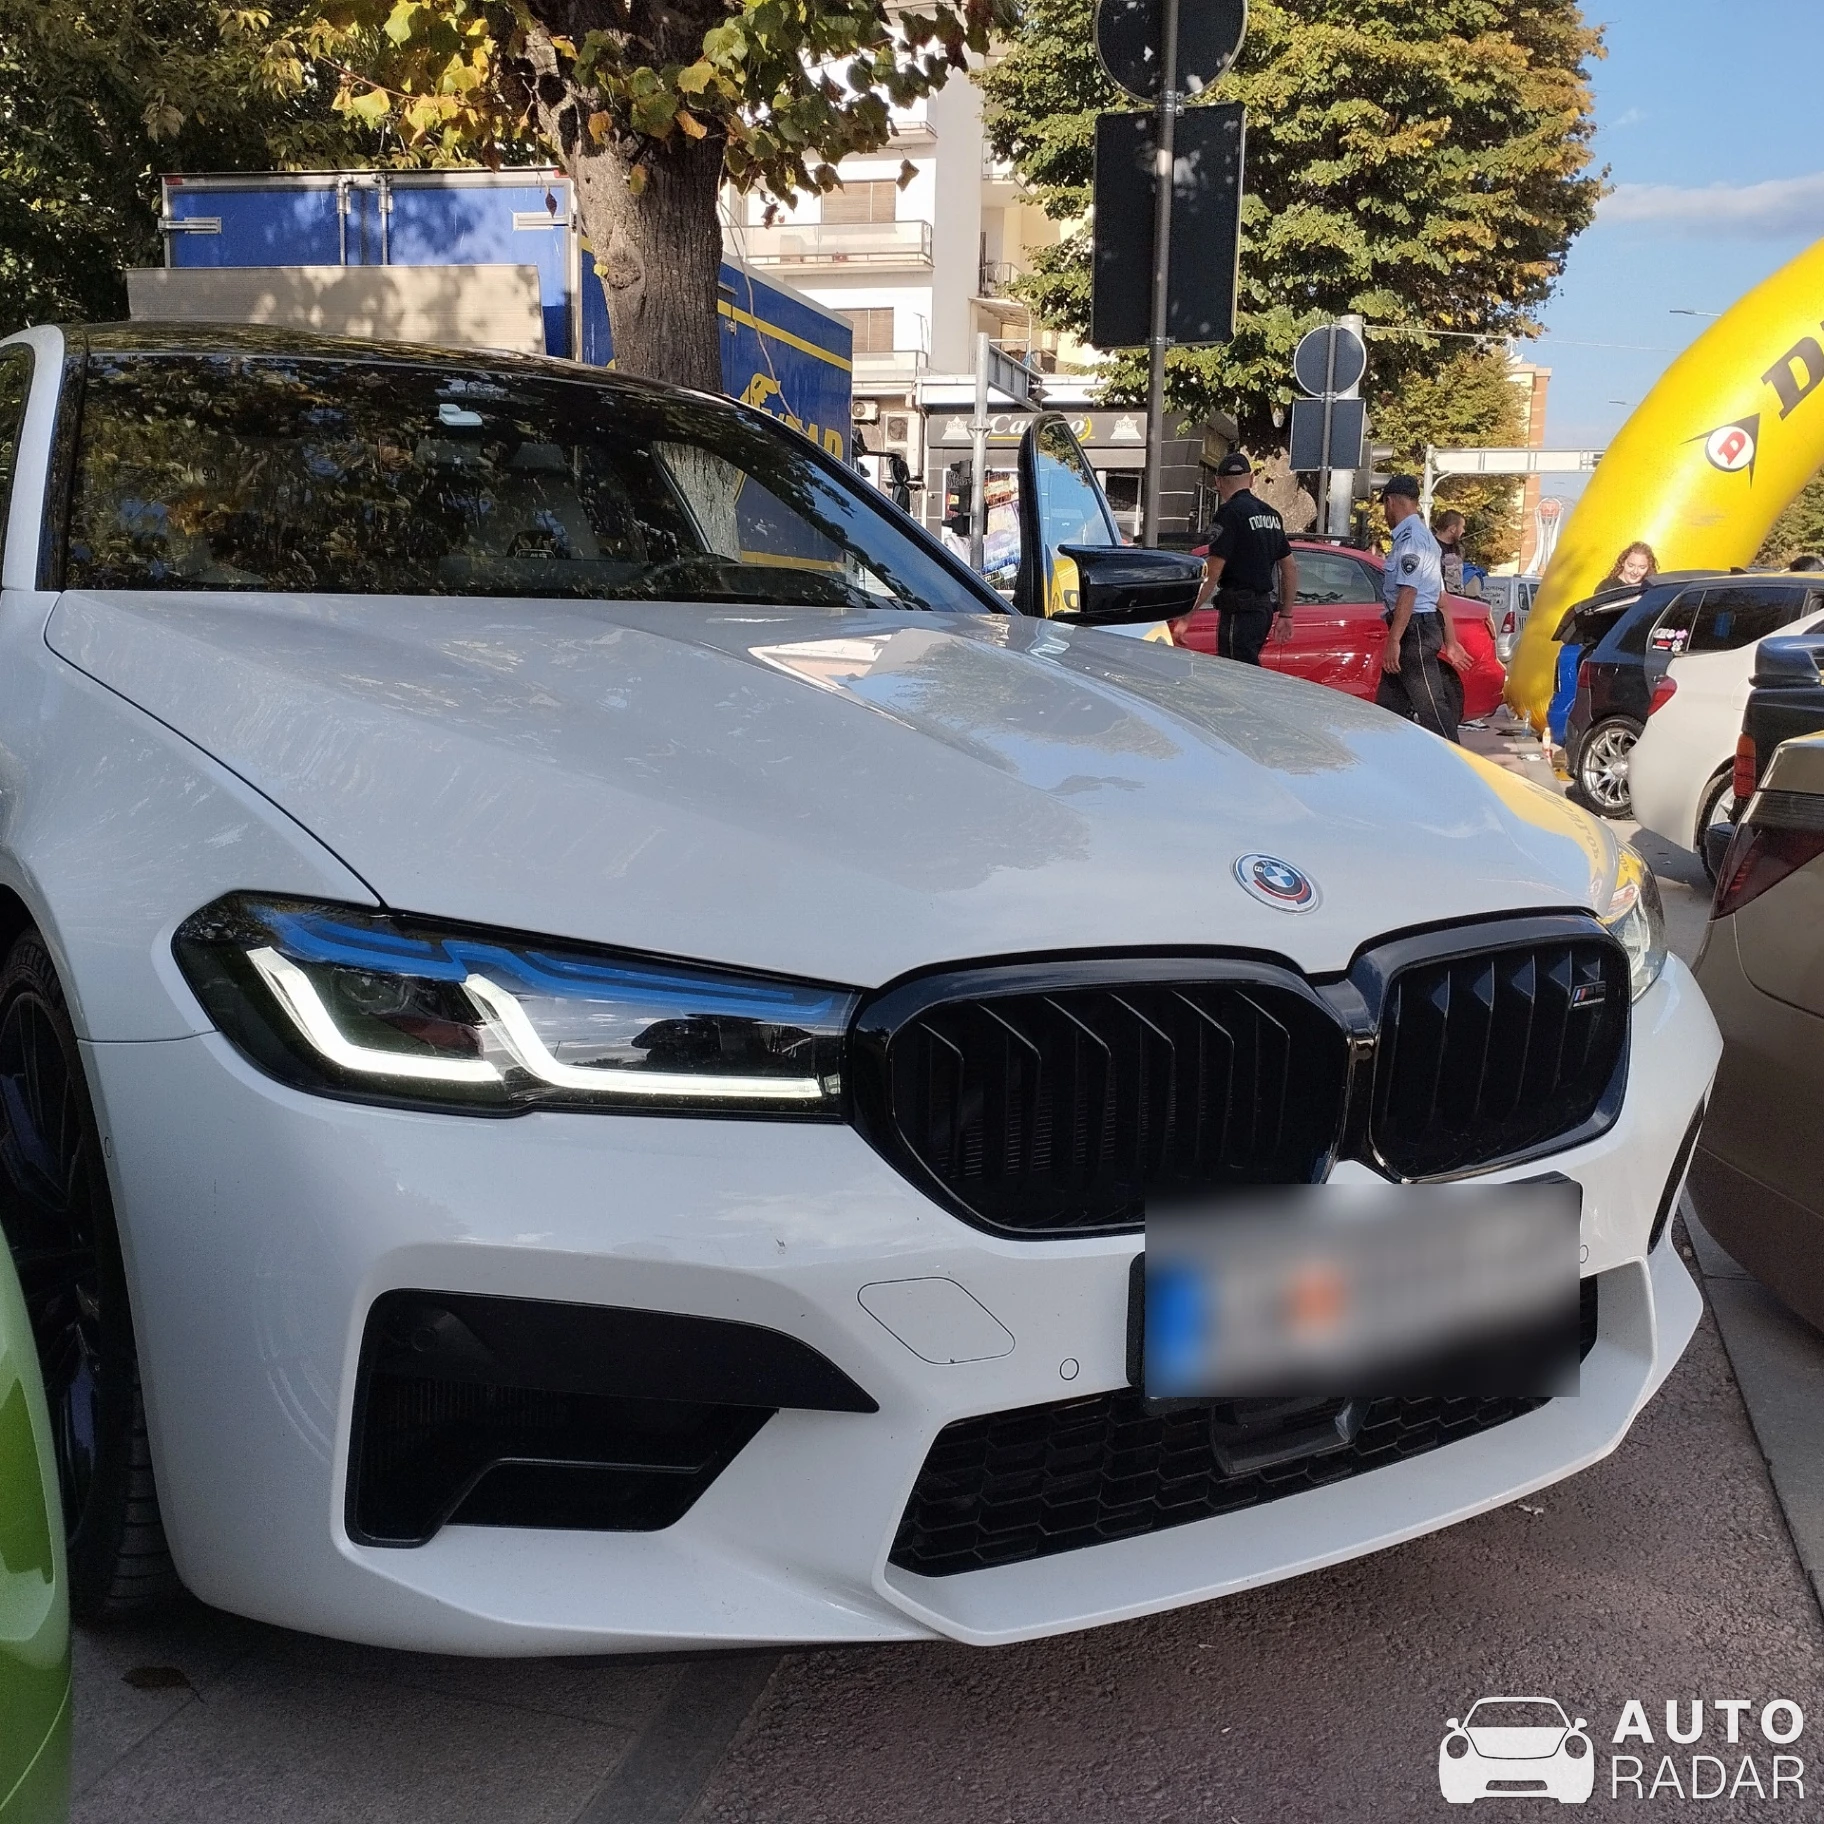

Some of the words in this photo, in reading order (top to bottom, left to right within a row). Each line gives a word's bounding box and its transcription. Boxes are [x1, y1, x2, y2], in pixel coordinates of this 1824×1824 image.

[1717, 431, 1746, 466] D
[1761, 321, 1824, 421] D
[1114, 420, 1137, 430] APEX
[202, 467, 217, 480] 90
